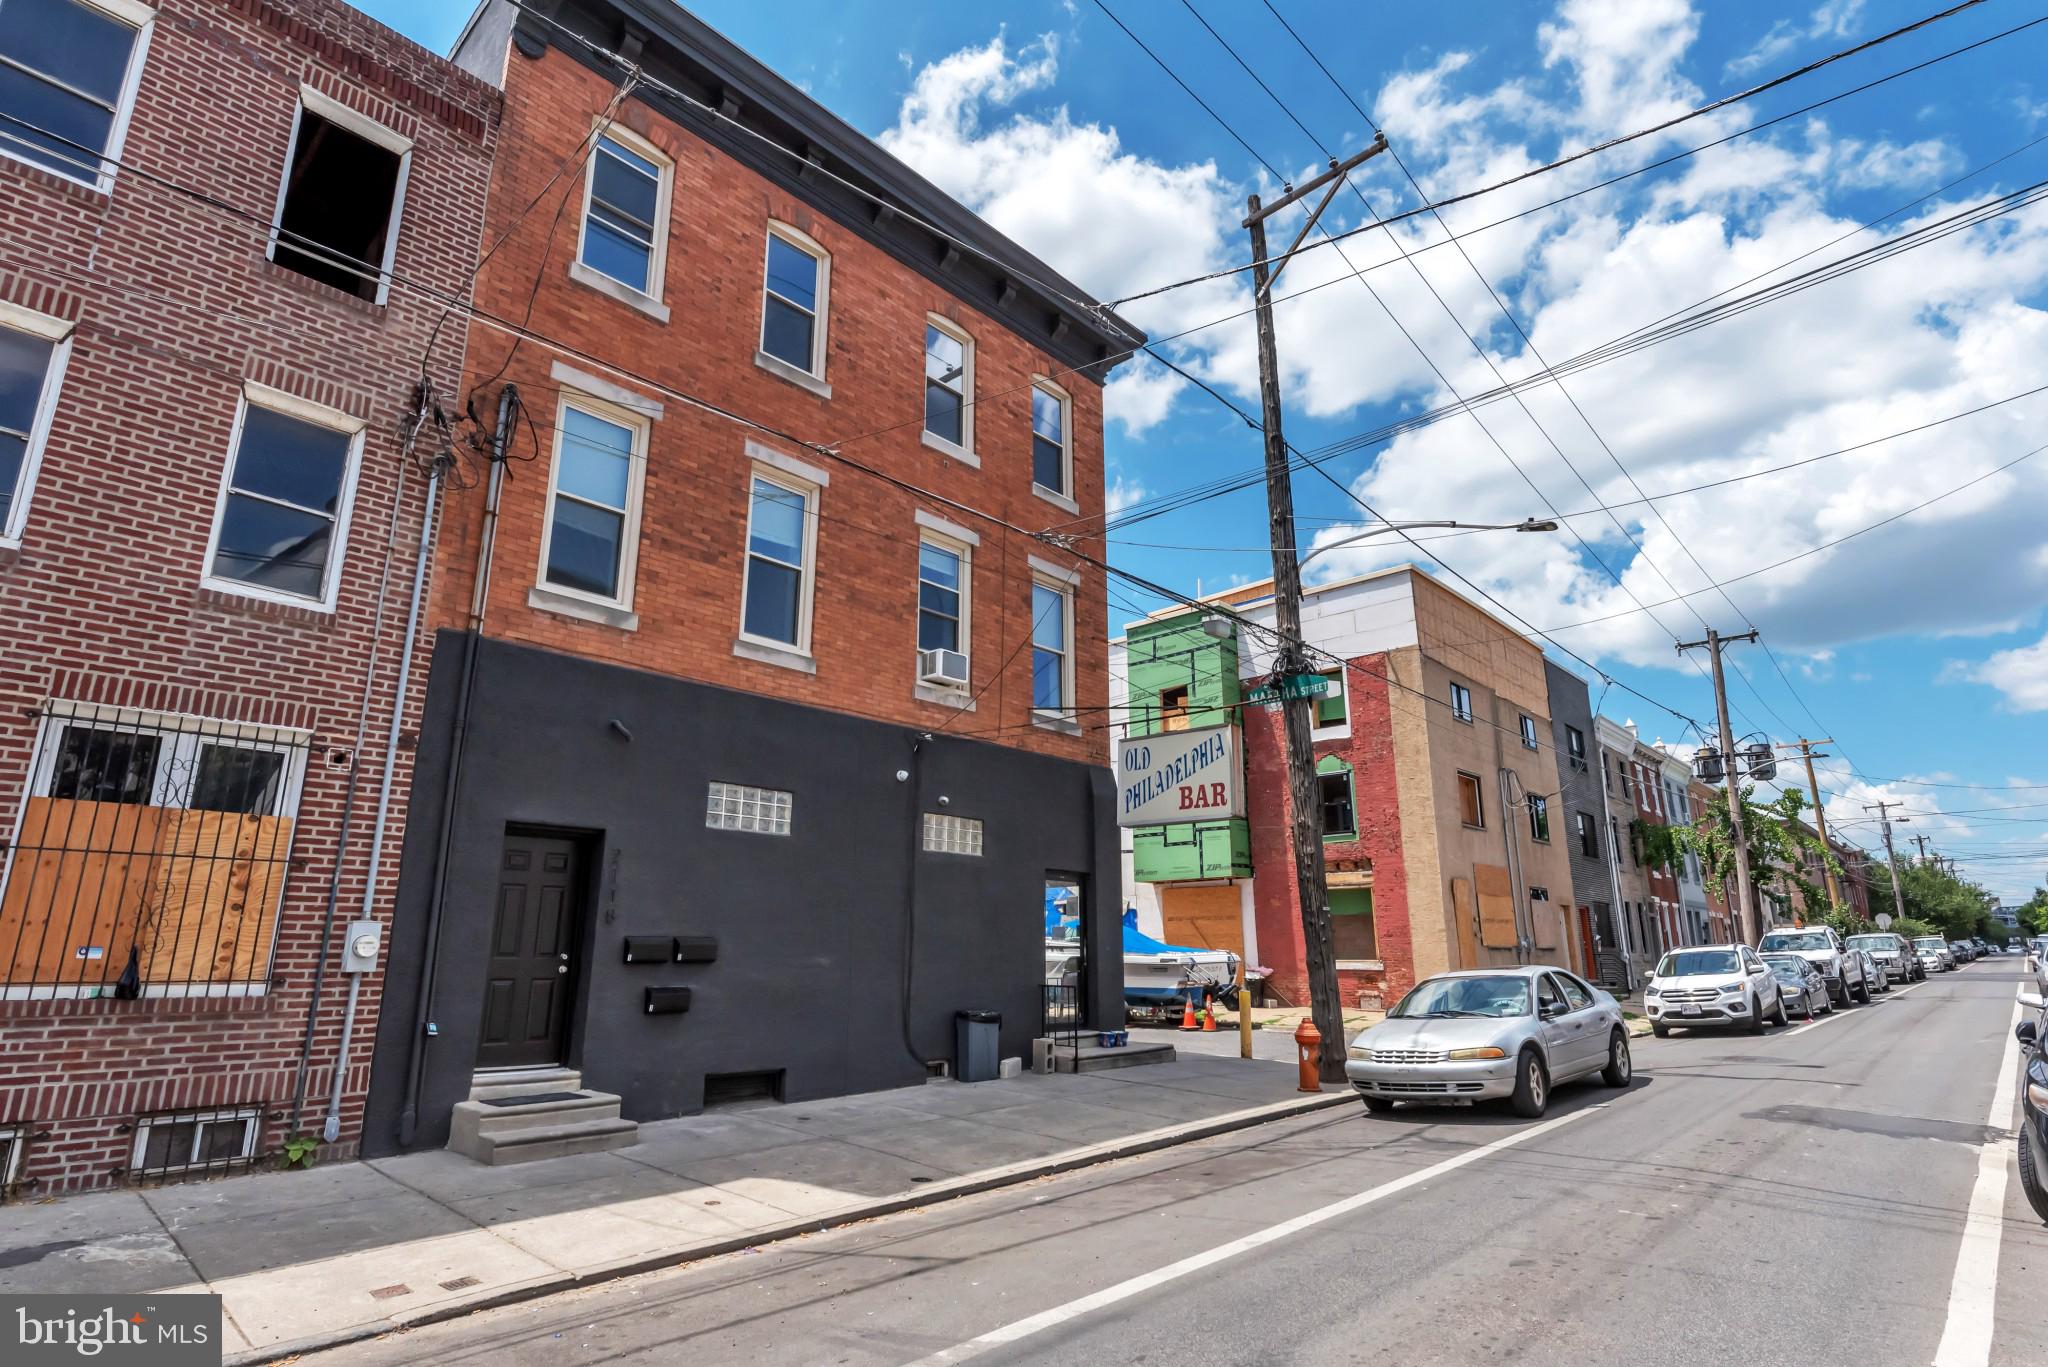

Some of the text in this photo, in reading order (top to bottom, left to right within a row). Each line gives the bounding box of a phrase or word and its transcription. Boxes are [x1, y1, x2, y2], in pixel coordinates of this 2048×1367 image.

[1301, 682, 1328, 696] STREET
[1125, 746, 1151, 772] OLD
[1125, 732, 1225, 814] PHILADELPHIA
[1179, 782, 1228, 810] BAR
